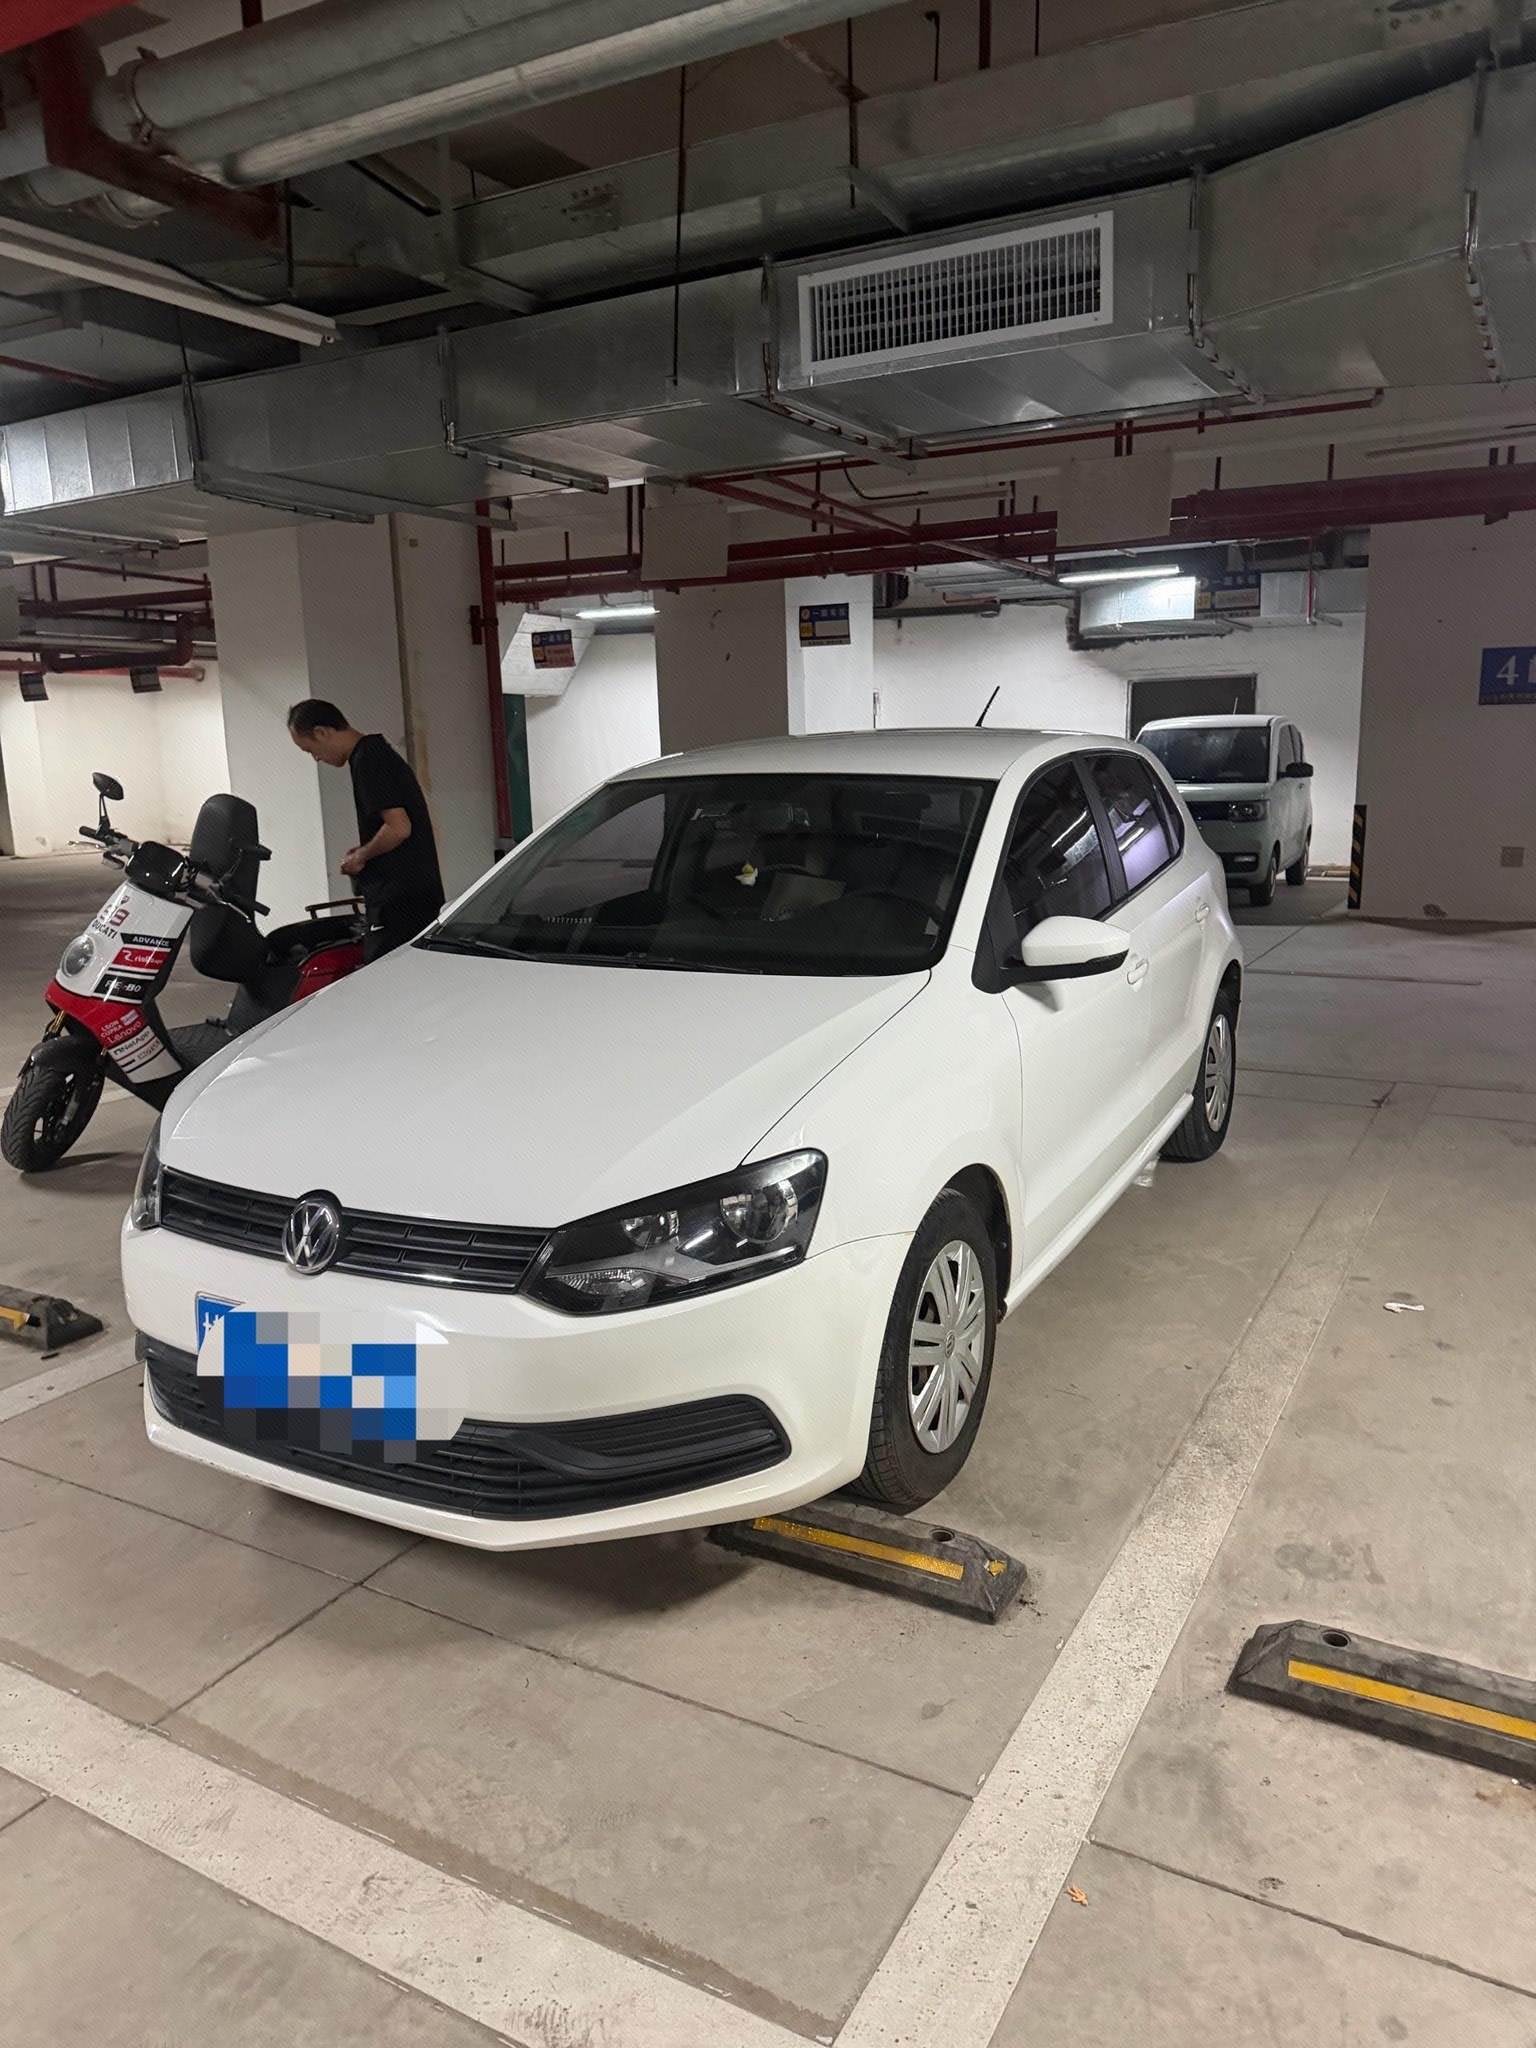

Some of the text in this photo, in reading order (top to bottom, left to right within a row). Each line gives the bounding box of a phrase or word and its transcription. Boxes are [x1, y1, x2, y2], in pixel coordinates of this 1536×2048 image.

[92, 920, 117, 938] DUCATI
[133, 936, 170, 946] ADVANCE
[101, 1020, 119, 1032] LEON
[107, 1021, 140, 1043] Lenovo
[119, 1030, 149, 1053] NetApp
